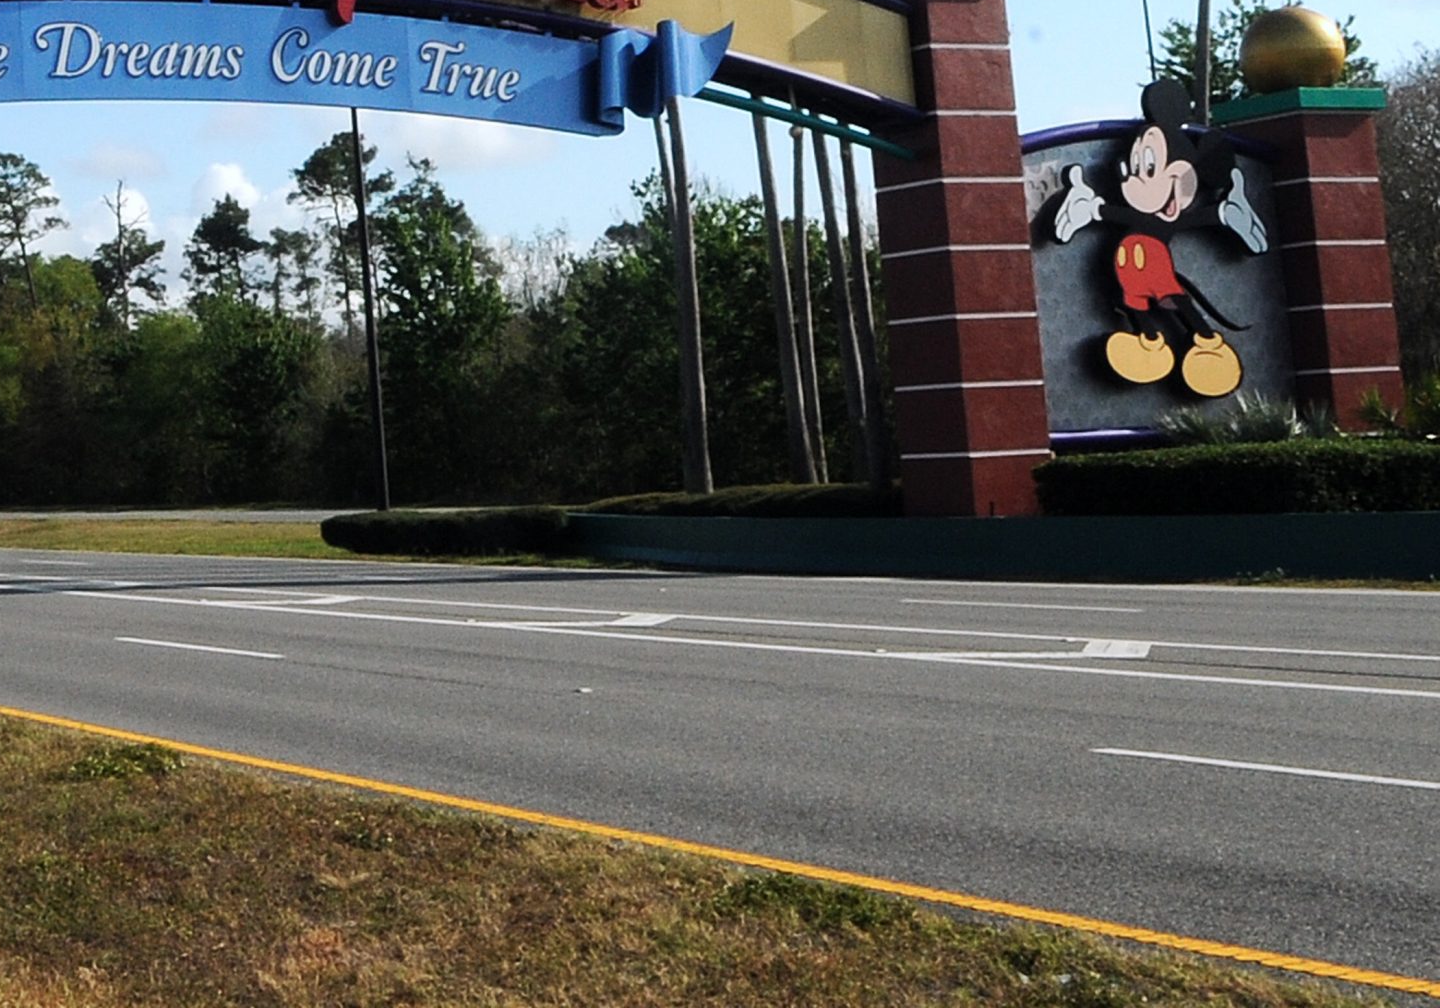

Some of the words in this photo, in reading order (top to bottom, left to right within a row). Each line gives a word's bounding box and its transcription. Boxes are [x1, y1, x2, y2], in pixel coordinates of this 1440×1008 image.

[34, 20, 245, 79] Dreams
[270, 26, 399, 88] Come
[419, 40, 521, 101] True
